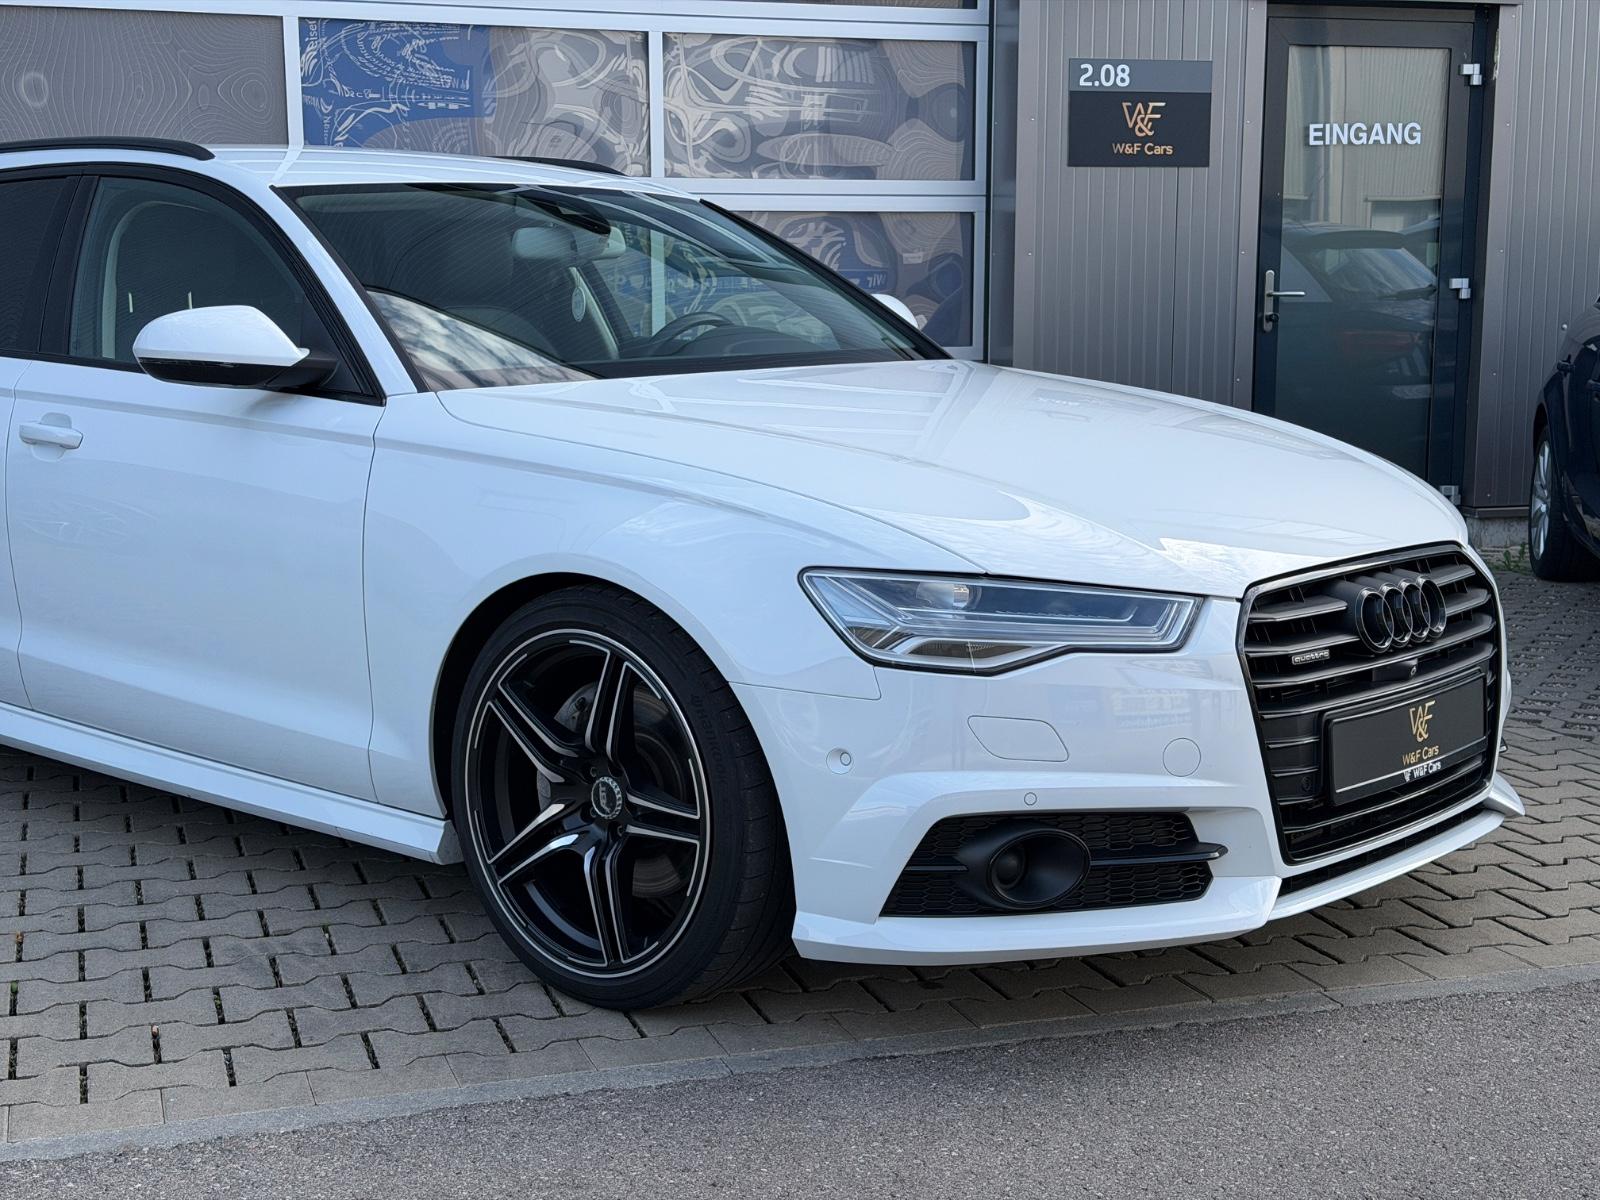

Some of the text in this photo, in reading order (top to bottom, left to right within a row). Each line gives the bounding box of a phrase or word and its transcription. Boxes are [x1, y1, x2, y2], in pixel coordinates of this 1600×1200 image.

[1078, 63, 1131, 88] 2.08
[1308, 123, 1422, 147] EINGANG
[1112, 142, 1174, 156] W&F Cars
[1295, 650, 1329, 663] quattro
[1402, 745, 1440, 766] W&F Cars
[1428, 761, 1442, 773] Cars
